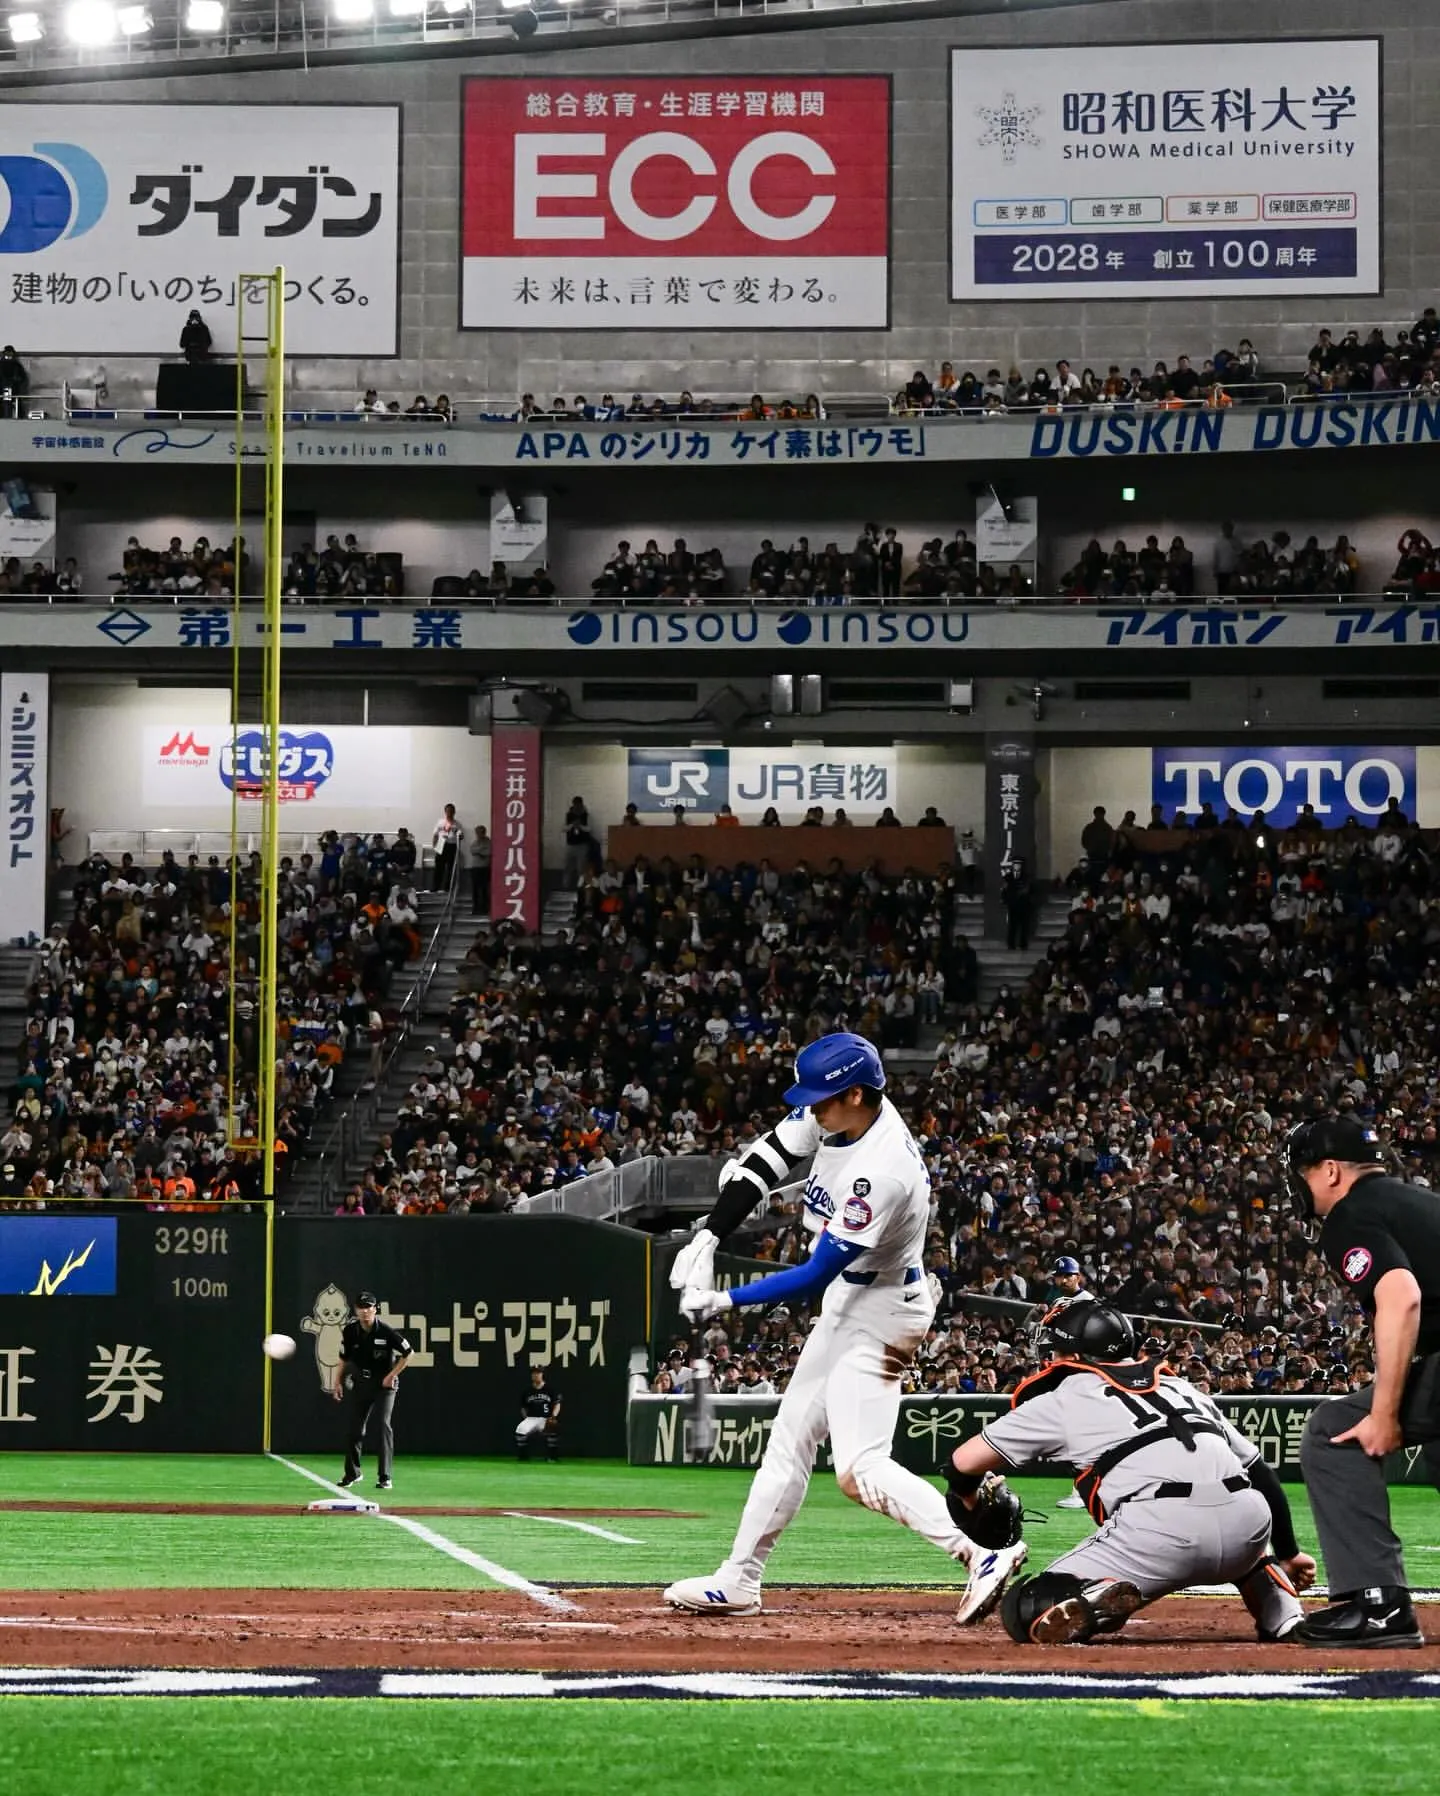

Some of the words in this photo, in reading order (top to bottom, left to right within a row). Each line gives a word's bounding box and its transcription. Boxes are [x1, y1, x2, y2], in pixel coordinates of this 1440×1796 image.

[526, 92, 825, 118] 総合教育・生涯学習機関
[1062, 86, 1357, 135] 昭和医科大学
[1063, 144, 1140, 159] SHOWA
[1150, 142, 1233, 158] Medical
[1244, 139, 1356, 157] University
[129, 165, 382, 237] ダイダン
[513, 131, 836, 241] ECC
[995, 203, 1047, 221] 医学部
[1187, 198, 1238, 216] 薬学部
[1268, 196, 1351, 214] 保健医療学部
[1012, 243, 1125, 273] 2028年
[12, 272, 370, 308] 建物の「いのち」をつくる。
[514, 276, 837, 305] 未来は、言葉で変わる。
[297, 442, 393, 456] Travelium
[515, 433, 590, 459] APA
[600, 433, 710, 460] のシリカ
[731, 430, 925, 459] ケイ素は「ウモ」
[178, 608, 463, 647] 第一工業
[1098, 609, 1288, 645] アイホン
[9, 706, 36, 868] シミズオクト
[647, 761, 710, 796] JR
[737, 763, 888, 801] JR貨物
[1164, 759, 1405, 815] TOTO
[504, 749, 527, 922] 三井のリハウス
[155, 1227, 228, 1254] 329ft
[172, 1277, 228, 1297] 100m
